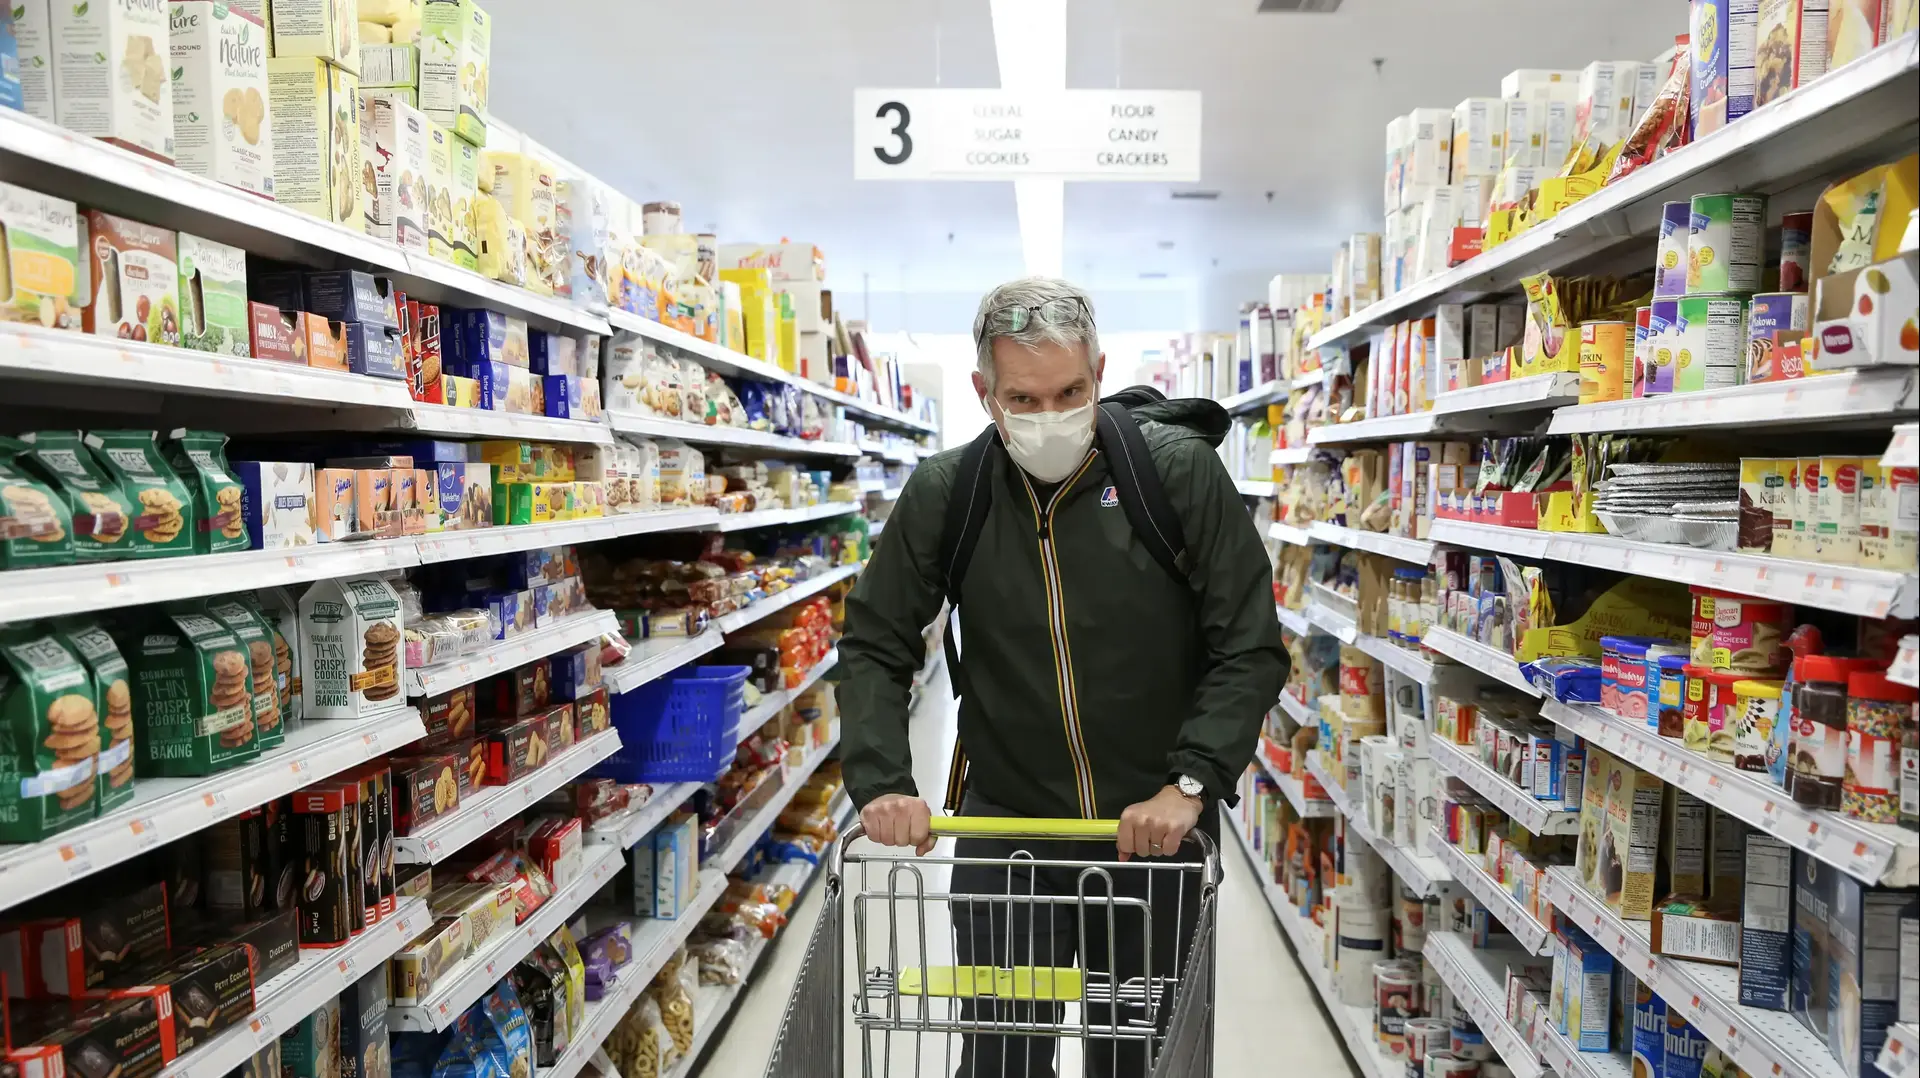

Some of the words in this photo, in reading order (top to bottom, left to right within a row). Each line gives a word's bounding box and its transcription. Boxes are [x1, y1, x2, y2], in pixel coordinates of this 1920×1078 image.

[973, 105, 1023, 118] CEREAL
[1111, 105, 1155, 118] FLOUR
[874, 101, 913, 165] 3
[974, 129, 1022, 141] SUGAR
[1108, 129, 1159, 142] CANDY
[966, 152, 1030, 165] COOKIES
[1097, 152, 1168, 166] CRACKERS
[352, 584, 386, 597] TATE'S
[316, 603, 341, 612] TATE'S
[311, 635, 343, 643] SIGNATURE
[1723, 636, 1749, 644] CHEESE
[313, 643, 345, 659] THIN
[314, 660, 346, 671] CRISPY
[140, 668, 185, 681] SIGNATURE
[314, 671, 347, 680] COOKIES
[141, 680, 188, 700] THIN
[315, 695, 348, 706] BAKING
[147, 699, 191, 716] CRISPY
[430, 703, 448, 714] Walkers
[147, 713, 192, 727] COOKIES
[150, 744, 193, 760] BAKING
[418, 778, 434, 790] Walkers
[68, 923, 82, 952] LU
[269, 939, 293, 959] DIGESTIVE
[214, 979, 229, 992] PETIT
[229, 967, 250, 982] ECOLIER
[158, 991, 172, 1020] LU
[361, 1005, 376, 1029] CHEESE
[115, 1034, 133, 1048] PETIT
[134, 1020, 158, 1037] ECOLIER
